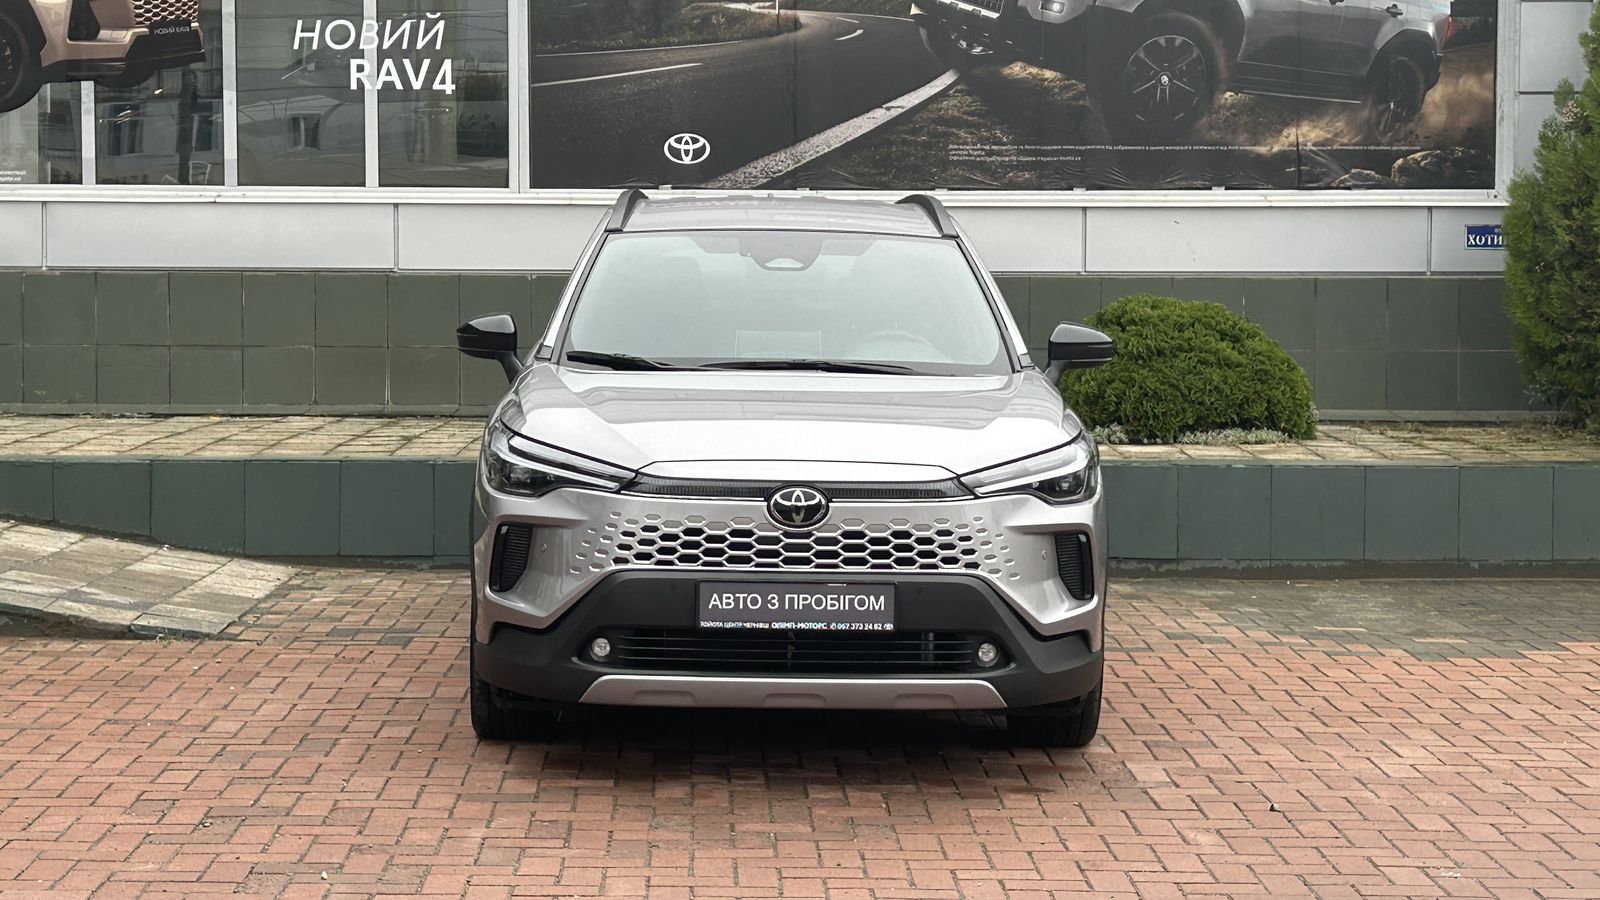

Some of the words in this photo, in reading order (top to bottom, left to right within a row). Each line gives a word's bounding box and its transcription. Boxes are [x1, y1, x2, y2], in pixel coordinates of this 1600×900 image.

[293, 12, 446, 50] НОВИЙ
[349, 58, 456, 94] RAV4
[1467, 234, 1505, 246] ХОТИ
[708, 593, 762, 610] АВТО
[767, 594, 779, 610] З
[785, 594, 885, 611] ПРОБІГОМ
